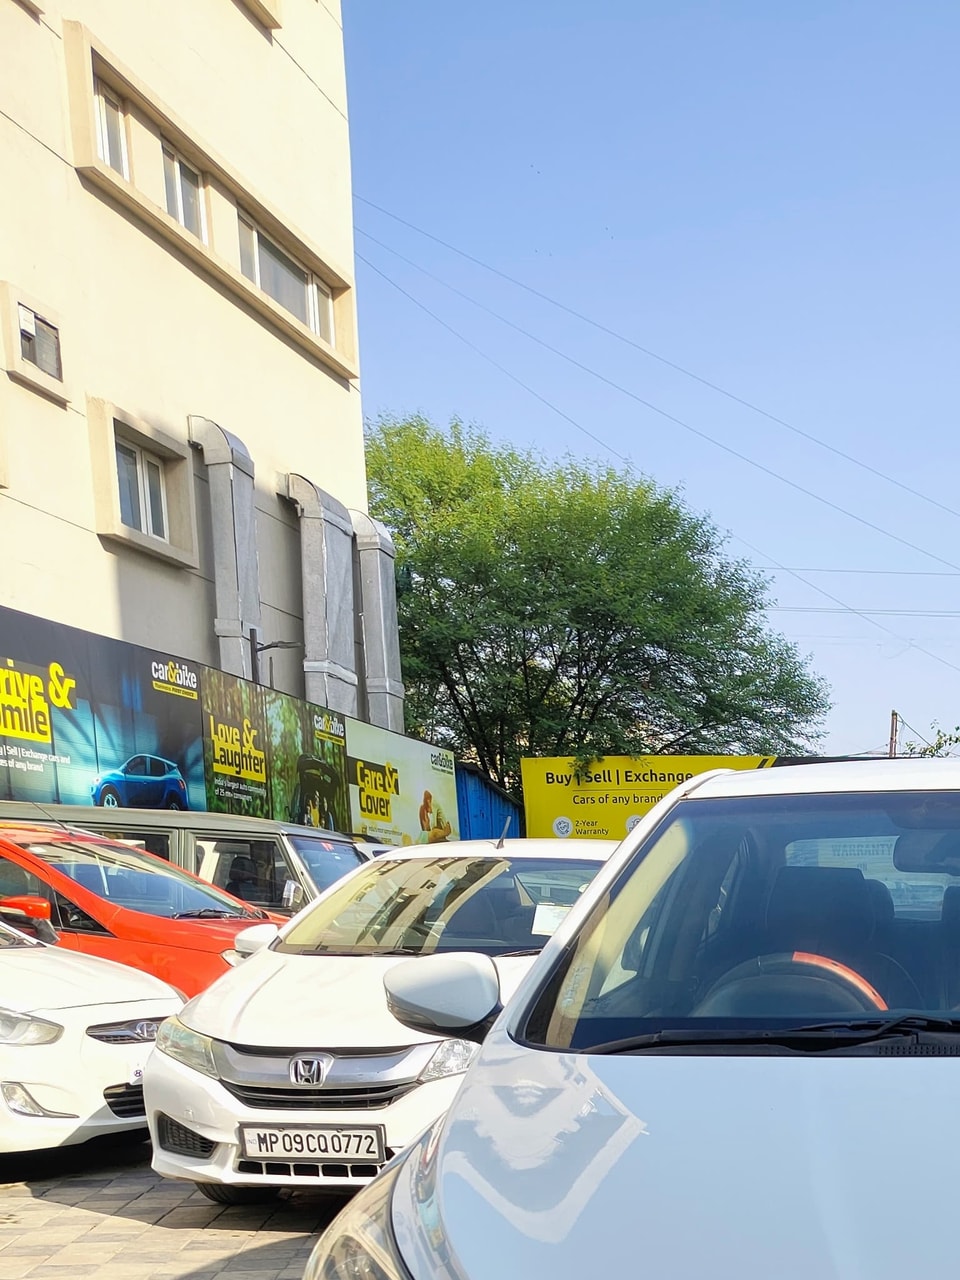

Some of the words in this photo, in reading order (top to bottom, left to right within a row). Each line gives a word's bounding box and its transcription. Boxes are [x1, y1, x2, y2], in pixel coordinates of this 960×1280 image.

[0, 658, 44, 701] rive
[48, 662, 76, 709] &
[151, 661, 197, 688] car&bike
[0, 699, 48, 736] mile
[210, 715, 240, 745] Love
[243, 718, 257, 750] &
[212, 742, 264, 775] Laughter
[357, 761, 384, 791] Care
[384, 761, 399, 794] &
[545, 772, 572, 786] Buy
[584, 770, 612, 783] Sell
[625, 769, 694, 784] Exchange
[359, 787, 390, 817] Cover
[573, 795, 595, 805] Cars
[599, 794, 609, 804] of
[612, 797, 630, 805] any
[633, 793, 664, 804] brand
[575, 828, 609, 836] Warranty
